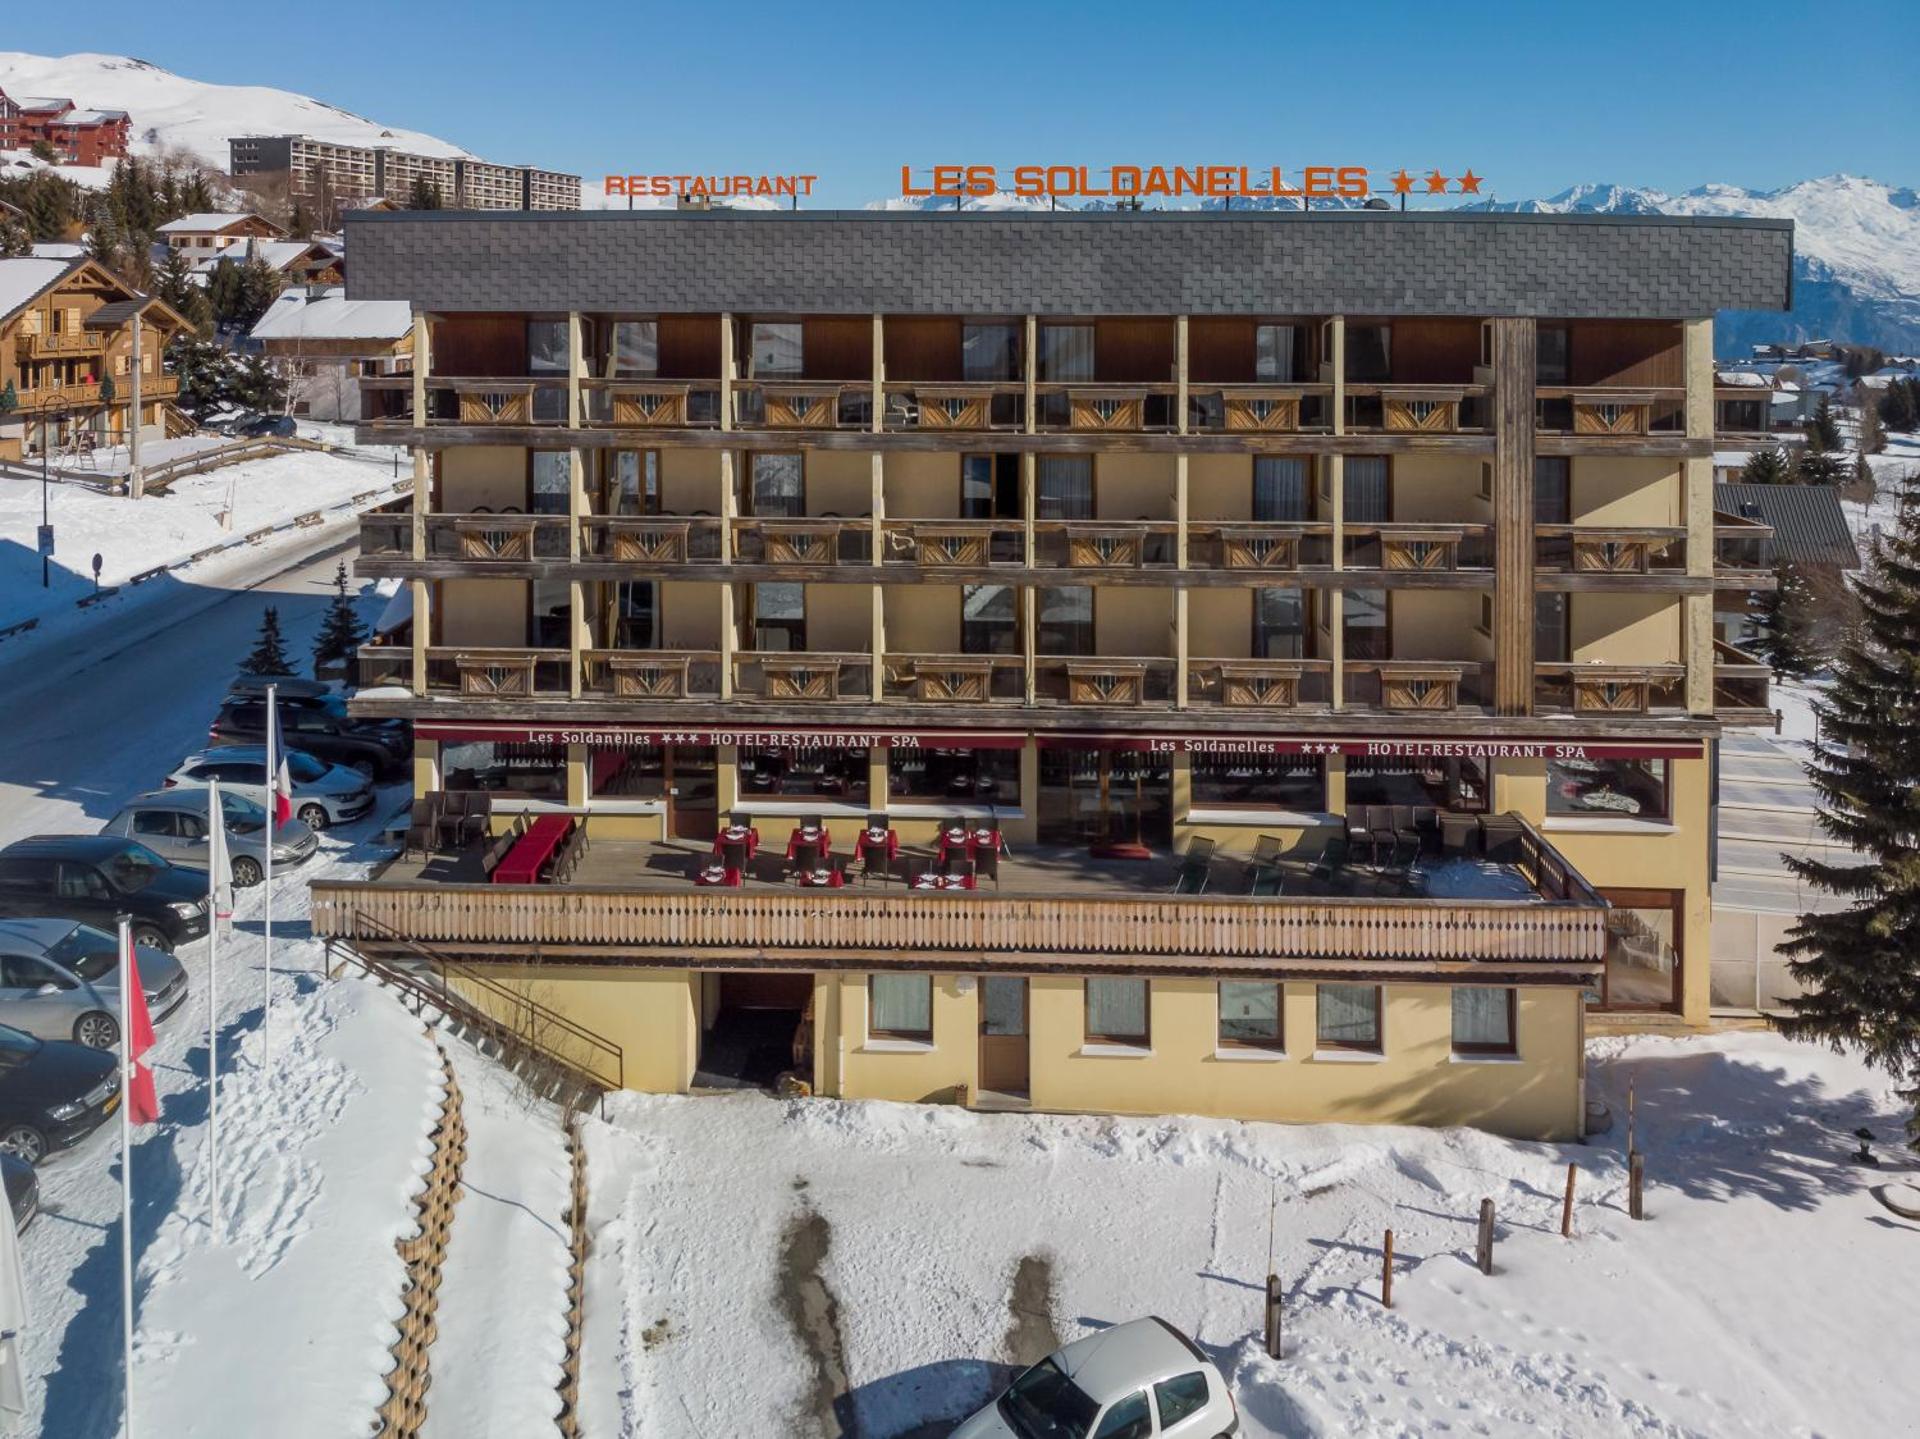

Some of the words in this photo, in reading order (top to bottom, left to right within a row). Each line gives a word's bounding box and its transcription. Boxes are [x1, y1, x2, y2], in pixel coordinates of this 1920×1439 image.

[604, 174, 818, 196] RESTAURANT
[901, 165, 997, 197] LES
[1014, 165, 1369, 197] SOLDANELLES
[528, 731, 555, 744] Les
[561, 731, 651, 746] Soldanelles
[891, 735, 920, 748] SPA
[1150, 739, 1176, 752] Les
[1184, 739, 1276, 754] Soldanelles
[1555, 744, 1586, 758] SPA
